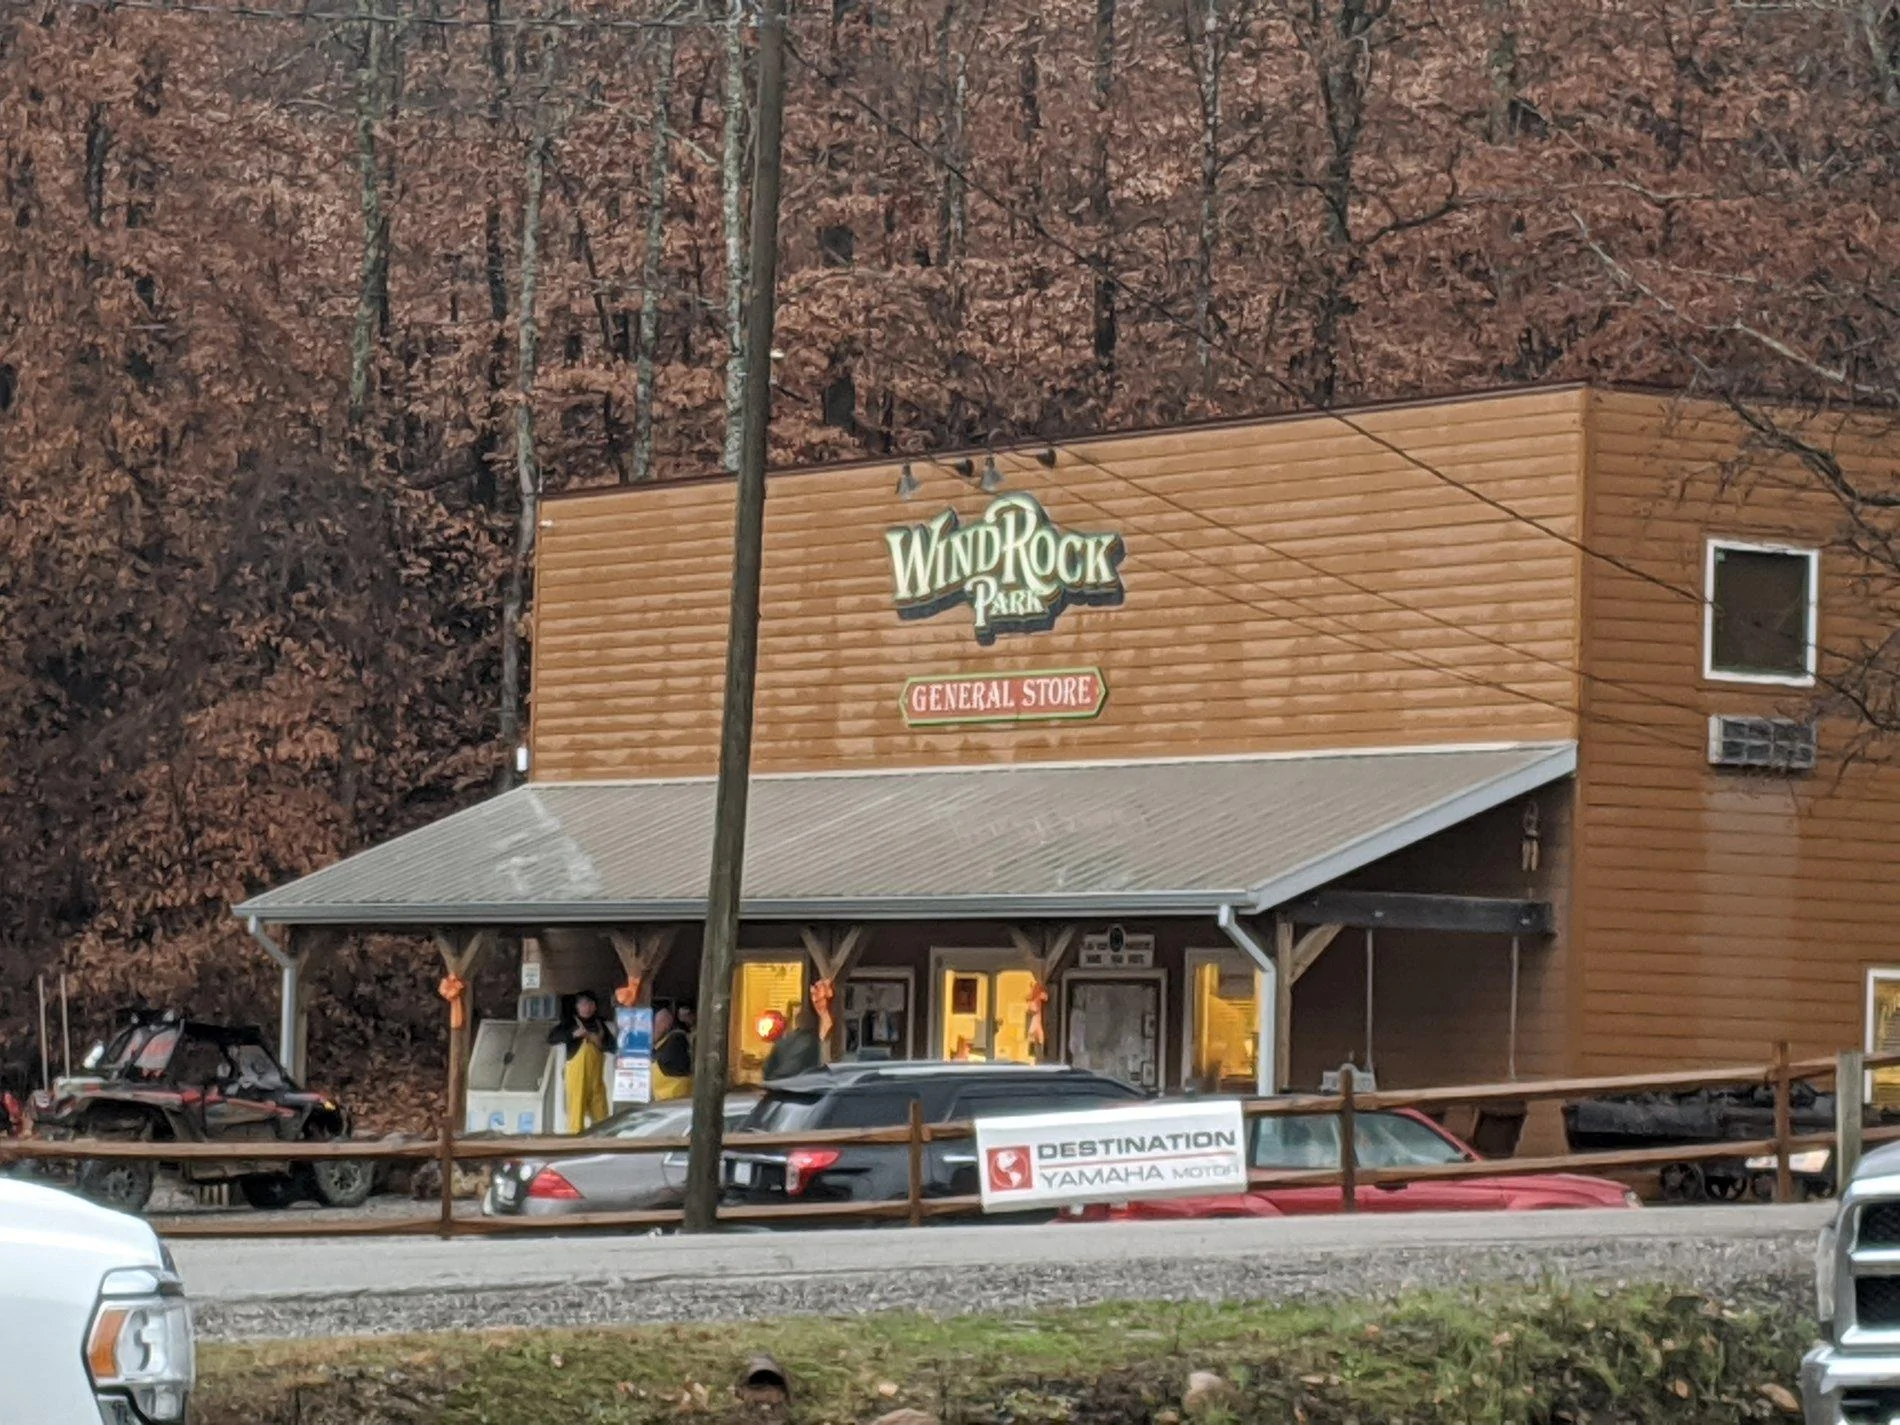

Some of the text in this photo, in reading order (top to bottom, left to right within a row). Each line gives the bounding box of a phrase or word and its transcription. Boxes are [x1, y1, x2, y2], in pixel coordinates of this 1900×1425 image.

[964, 576, 1044, 627] PARK
[911, 676, 1092, 712] GENERAL STORE
[1037, 1130, 1236, 1160] DESTINATION
[1040, 1165, 1164, 1189] YAMAHA
